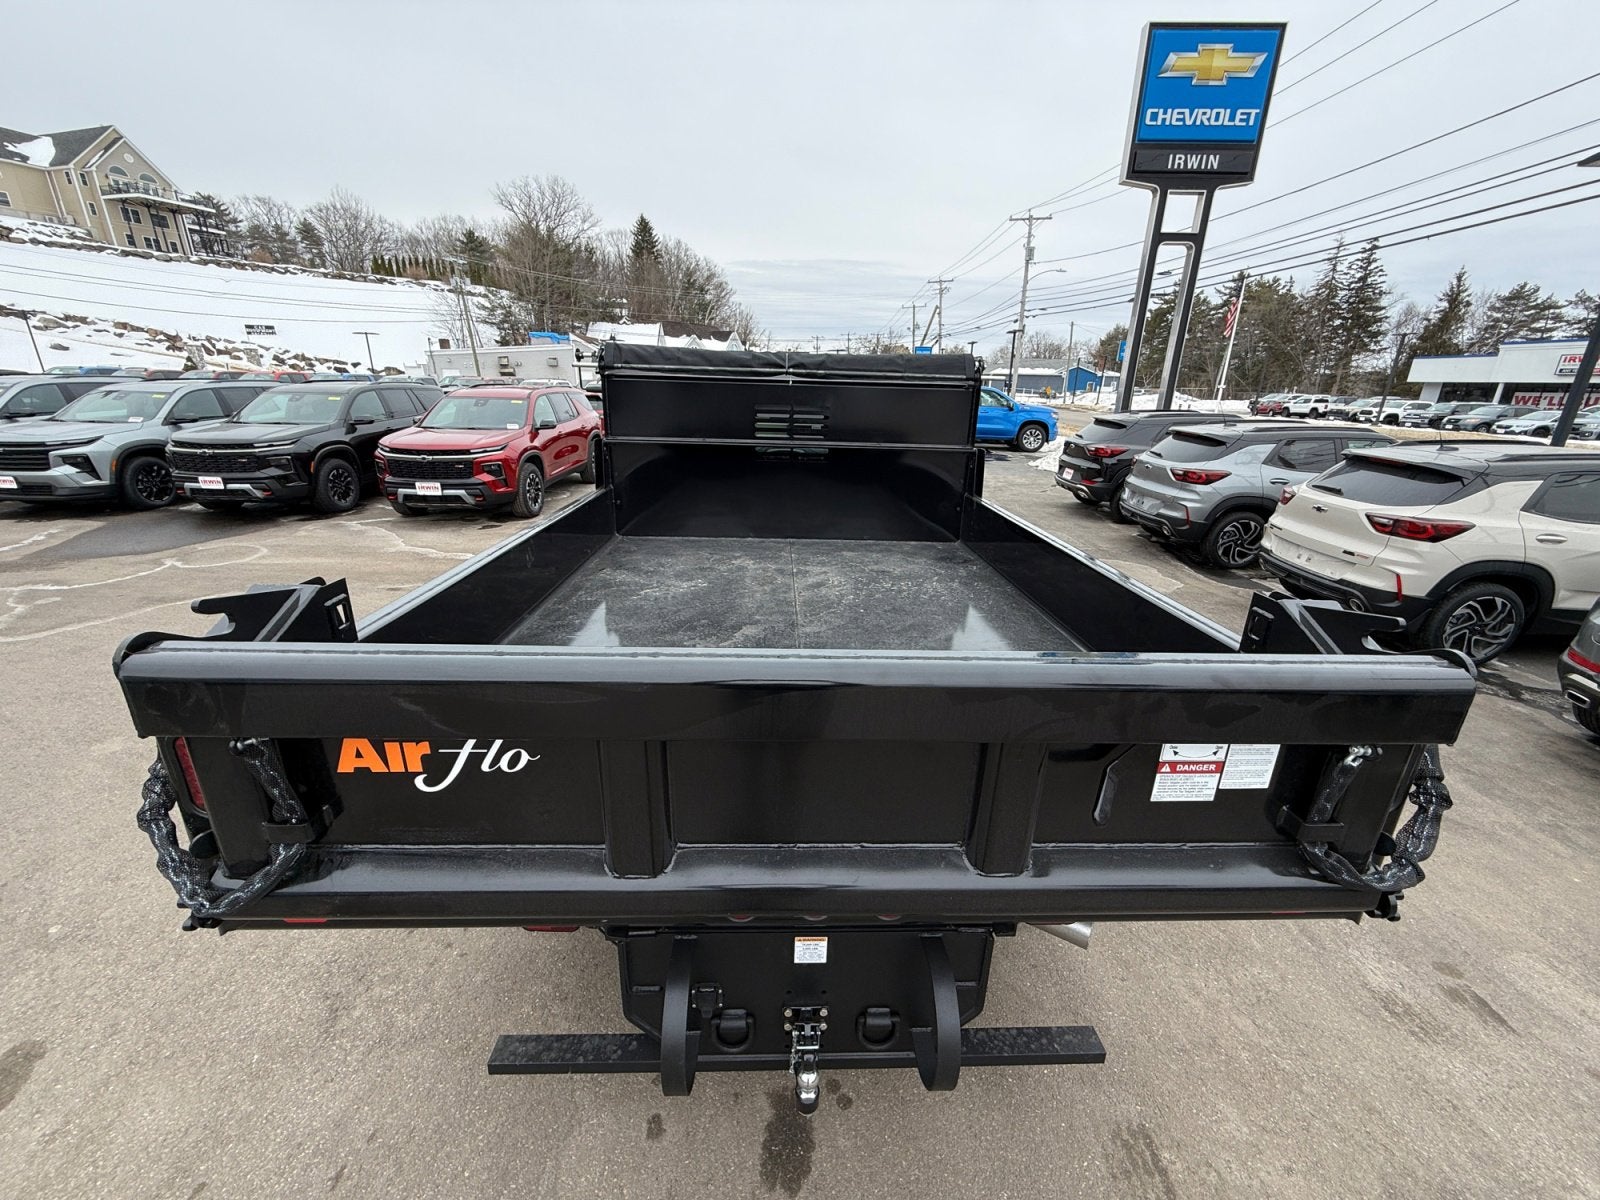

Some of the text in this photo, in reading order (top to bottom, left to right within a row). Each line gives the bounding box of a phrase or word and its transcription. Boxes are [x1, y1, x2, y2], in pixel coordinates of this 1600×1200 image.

[1145, 108, 1260, 126] CHEVROLET
[1167, 153, 1220, 170] IRWIN
[1175, 764, 1217, 772] DANGER
